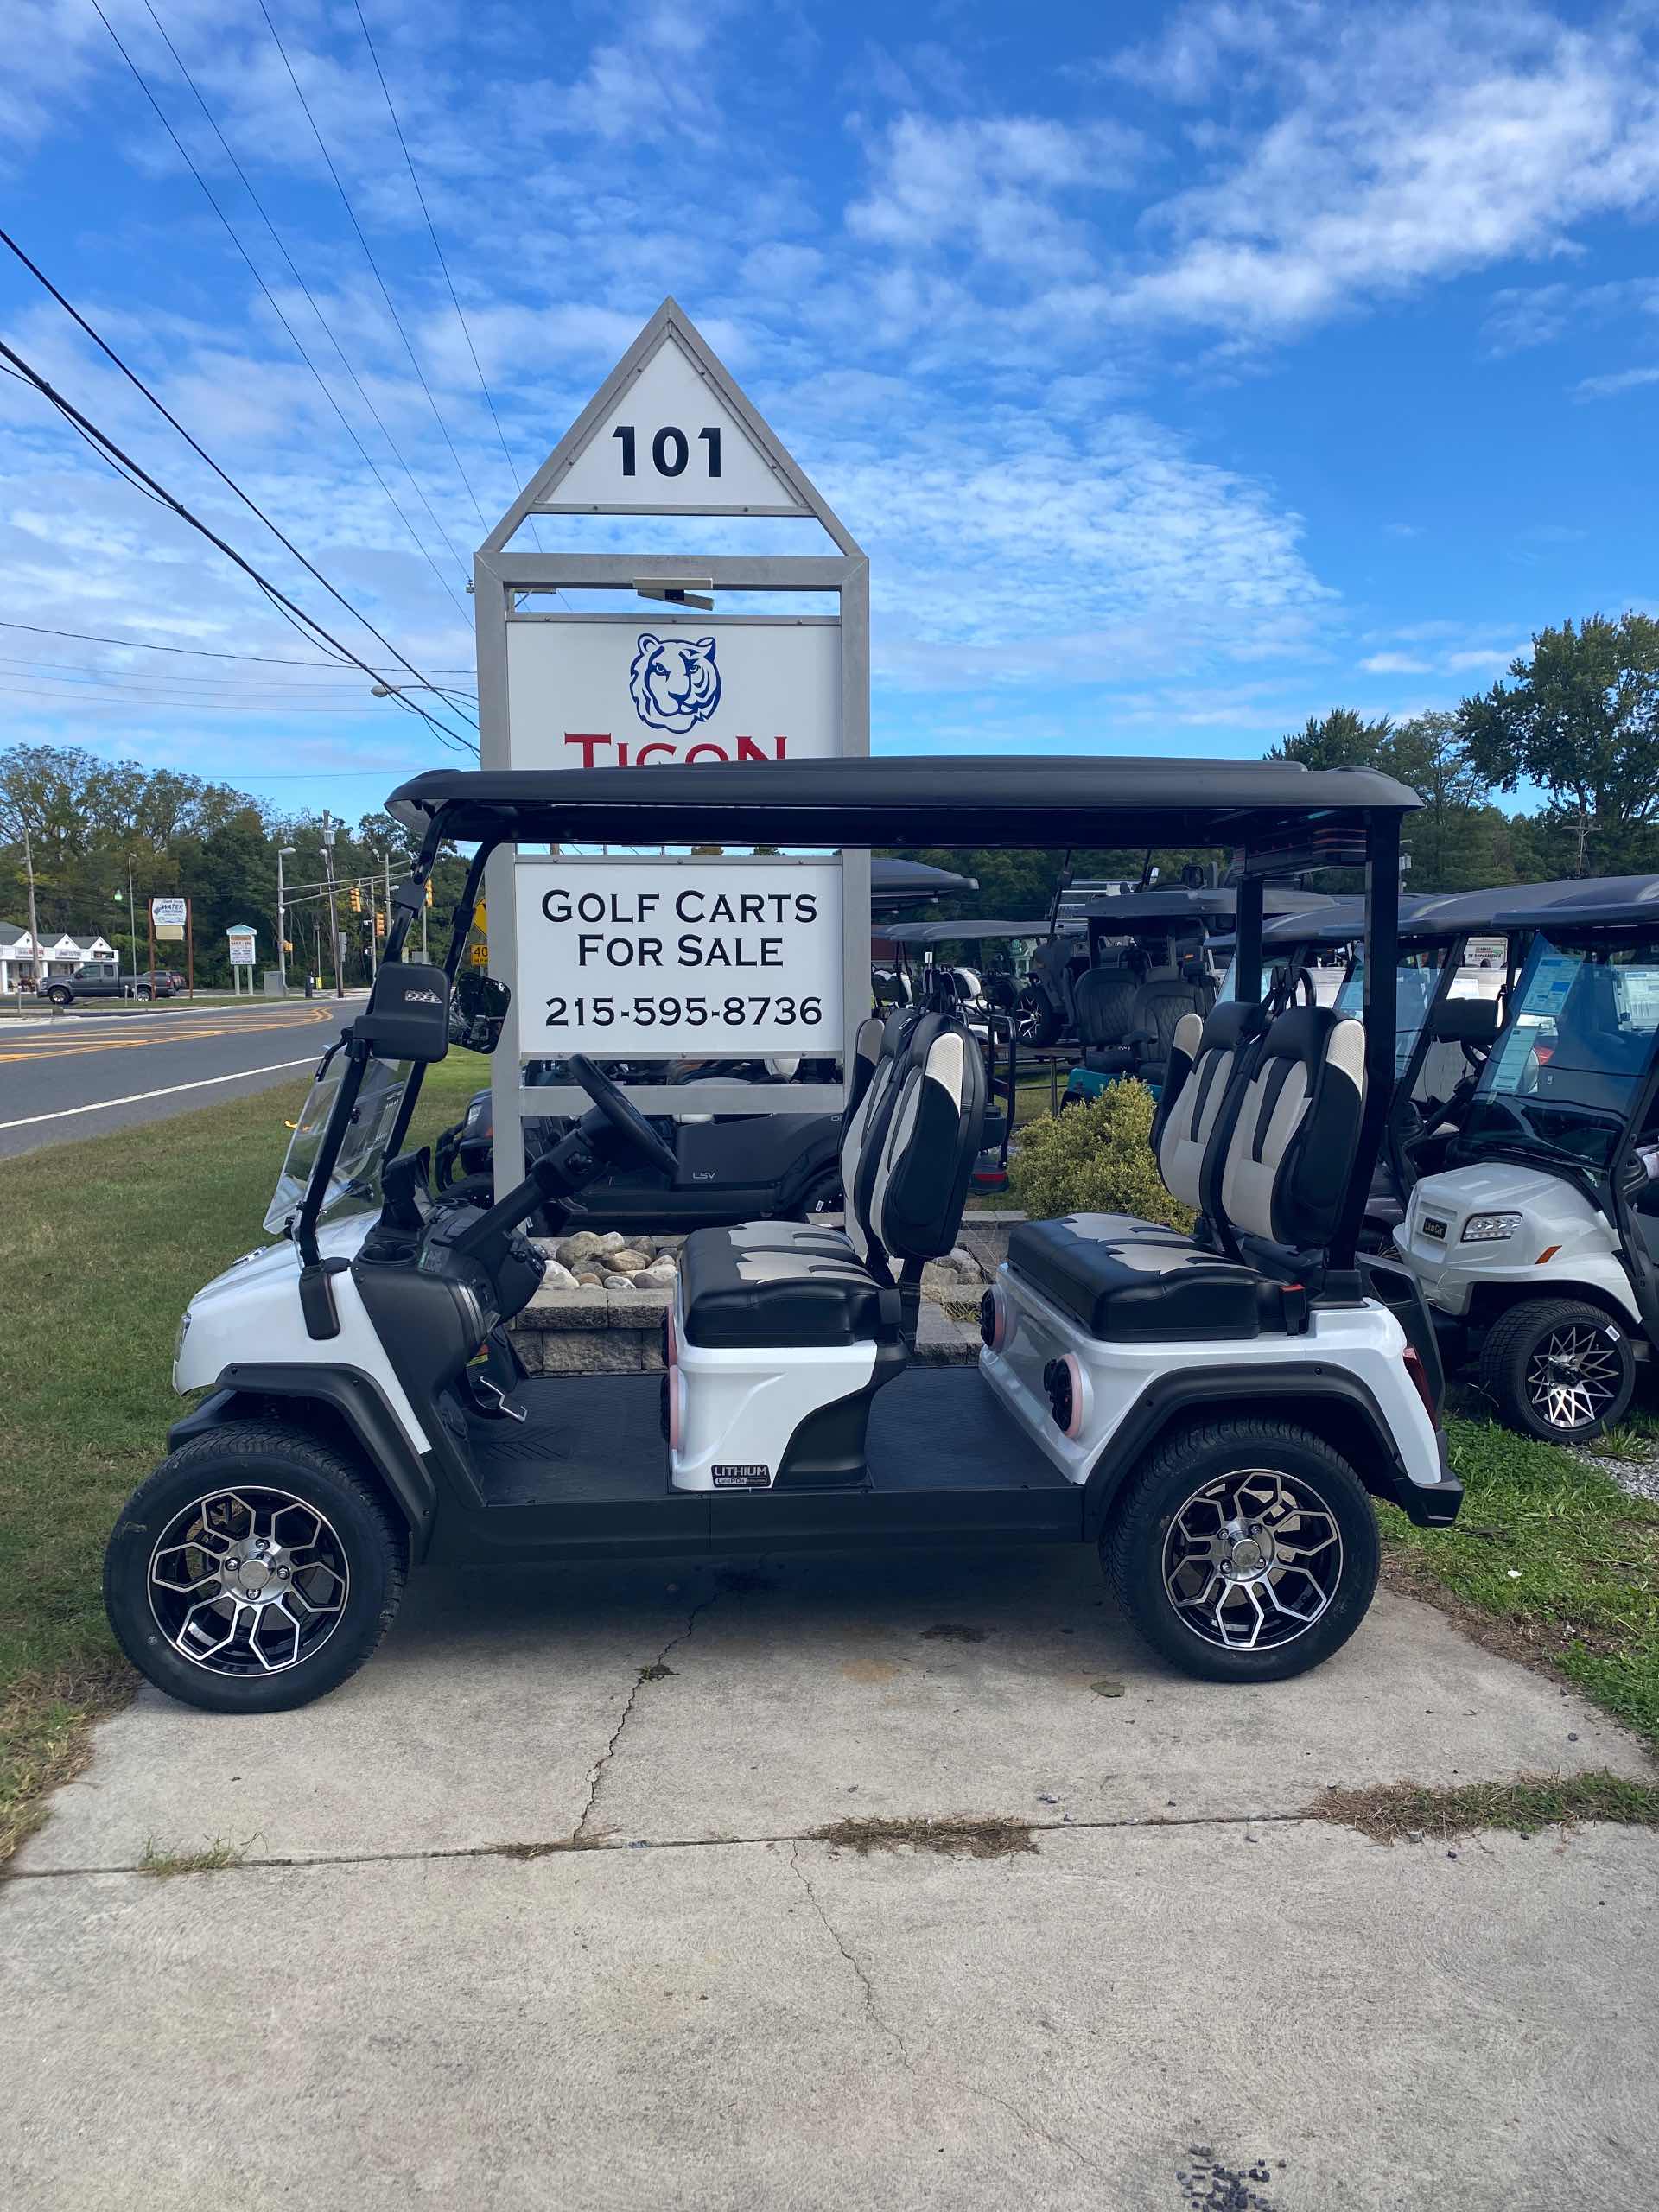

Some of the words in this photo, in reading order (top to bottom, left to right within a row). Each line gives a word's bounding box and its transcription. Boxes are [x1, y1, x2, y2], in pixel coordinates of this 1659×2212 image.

[612, 426, 721, 478] 101
[541, 889, 660, 923] GOLF
[675, 889, 817, 924] CARTS
[474, 946, 488, 957] 40
[577, 933, 664, 967] FOR
[677, 933, 784, 967] SALE
[545, 996, 823, 1027] 215-595-8736
[715, 1466, 767, 1476] LITHIUM
